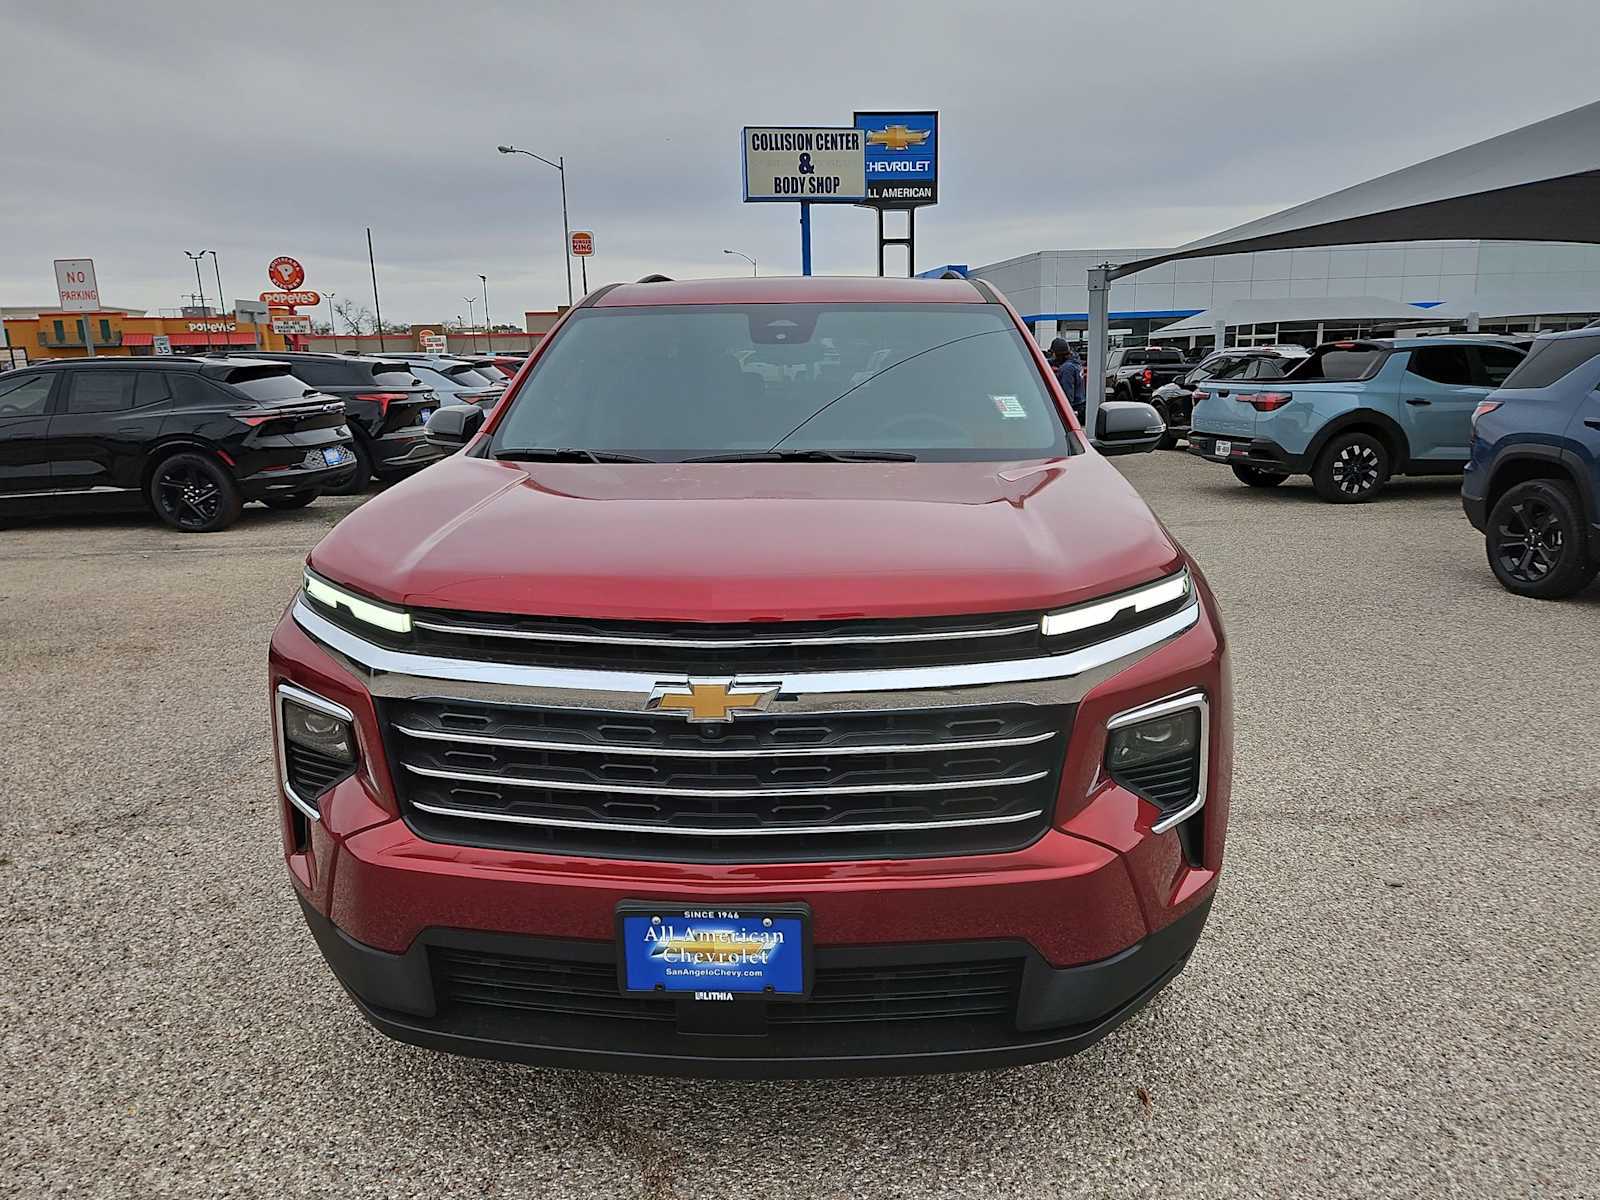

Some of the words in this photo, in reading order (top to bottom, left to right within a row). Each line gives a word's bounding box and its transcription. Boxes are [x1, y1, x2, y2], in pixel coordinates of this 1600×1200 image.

[752, 133, 813, 151] COLLISION
[816, 133, 860, 151] CENTER
[798, 153, 815, 174] &
[774, 176, 806, 194] BODY
[809, 176, 840, 194] SHOP
[868, 188, 880, 198] LL
[882, 187, 932, 198] AMERICAN
[66, 271, 85, 283] NO
[61, 290, 97, 301] PARKING
[684, 911, 715, 919] SINCE
[717, 911, 740, 919] 1946
[643, 926, 674, 942] All
[683, 927, 785, 944] American
[663, 947, 769, 964] Chevrolet
[665, 968, 763, 977] SanAngeloChevy.com
